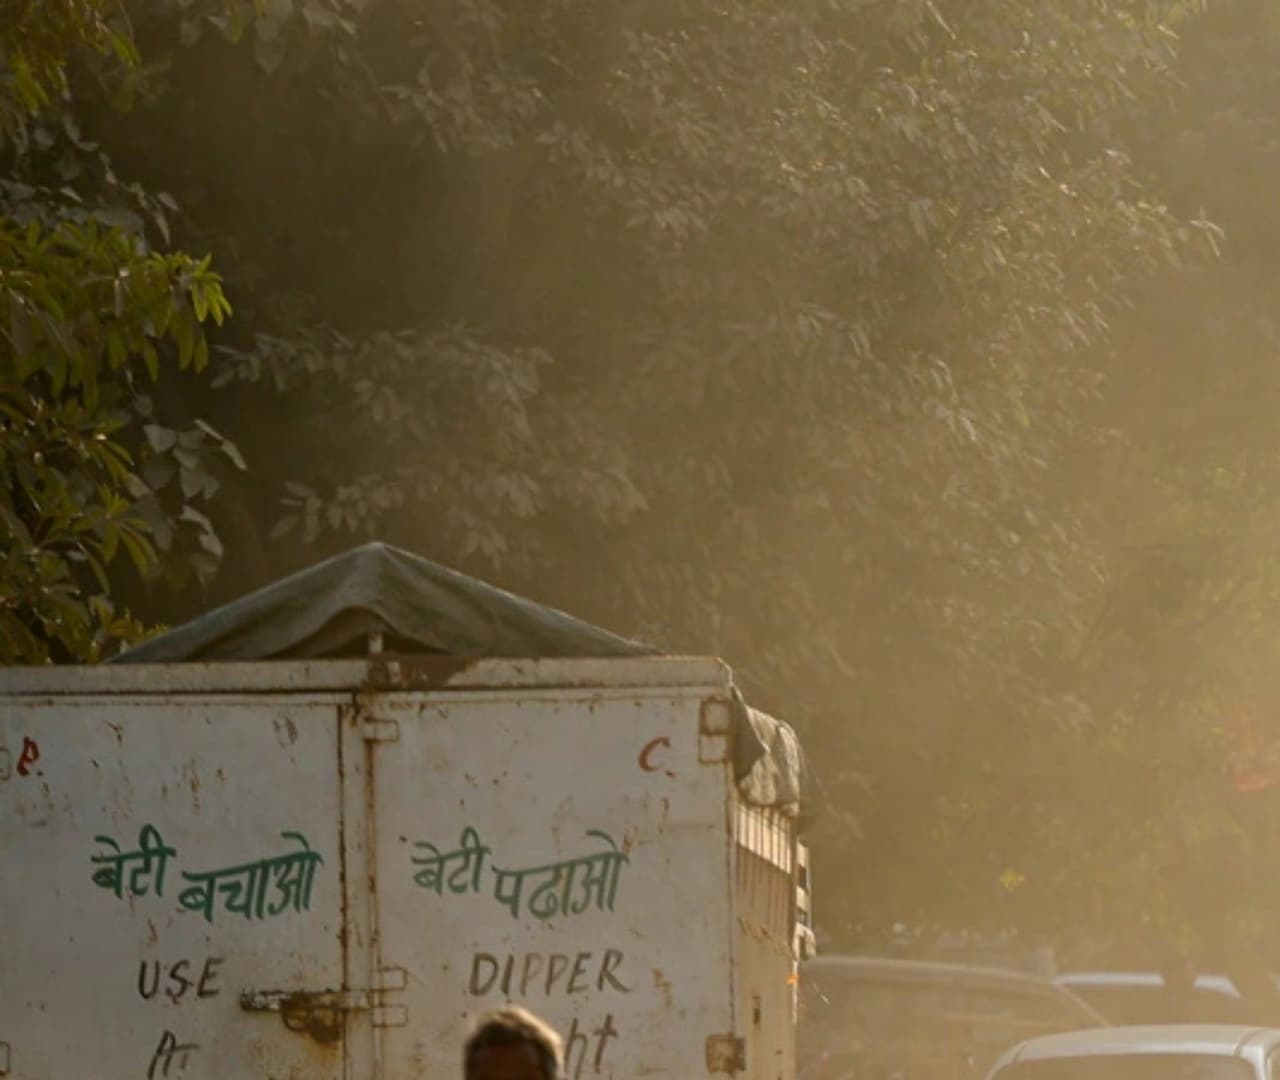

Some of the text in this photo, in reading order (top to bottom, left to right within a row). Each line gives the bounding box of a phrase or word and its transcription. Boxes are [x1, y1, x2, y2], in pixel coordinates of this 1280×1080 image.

[91, 823, 177, 899] बेटी
[178, 831, 324, 923] बचाओ
[411, 826, 492, 896] बेटी
[138, 949, 631, 1005] USE DIPPER
